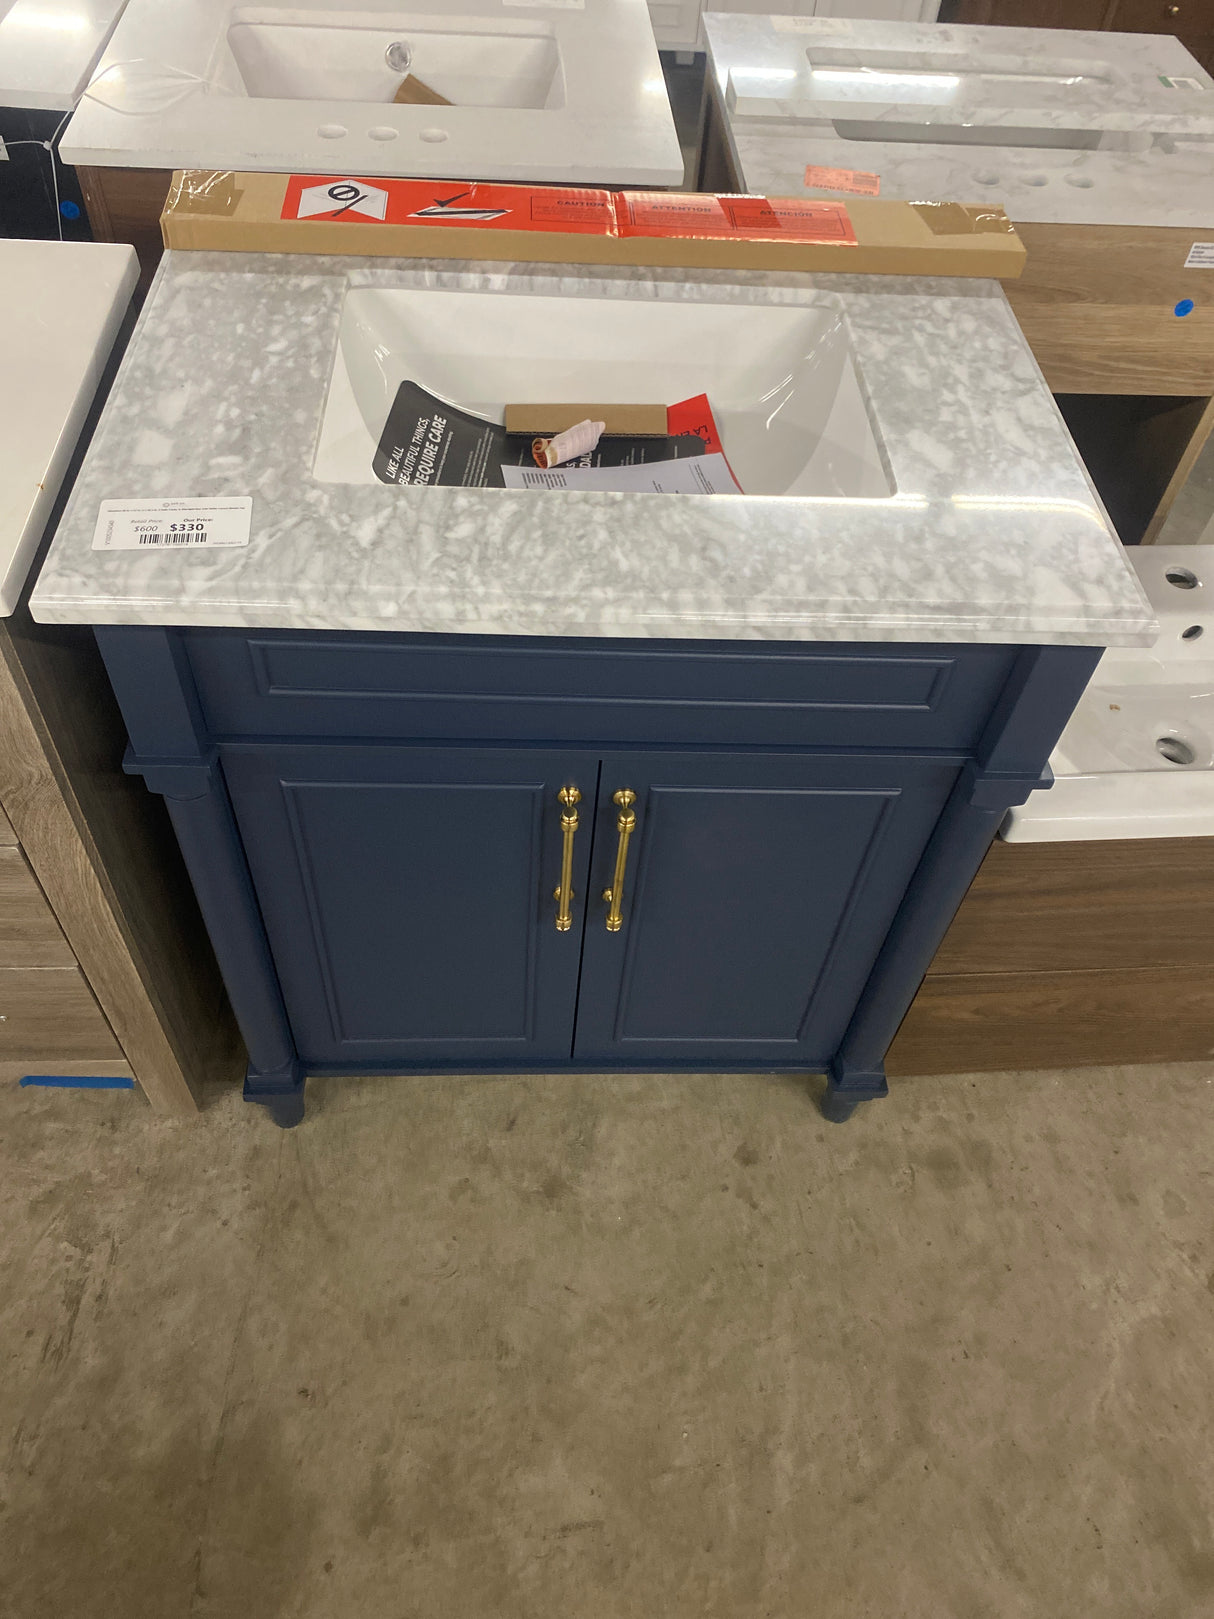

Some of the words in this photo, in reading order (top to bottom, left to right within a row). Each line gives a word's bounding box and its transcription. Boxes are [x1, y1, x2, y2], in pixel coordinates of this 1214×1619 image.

[391, 446, 404, 463] ALL
[398, 445, 420, 485] BEAUTIFUL
[412, 417, 430, 446] THINGS,
[413, 441, 439, 486] REQUIRE
[428, 414, 447, 443] CARE
[385, 458, 400, 479] LIKE
[169, 523, 204, 532] $330
